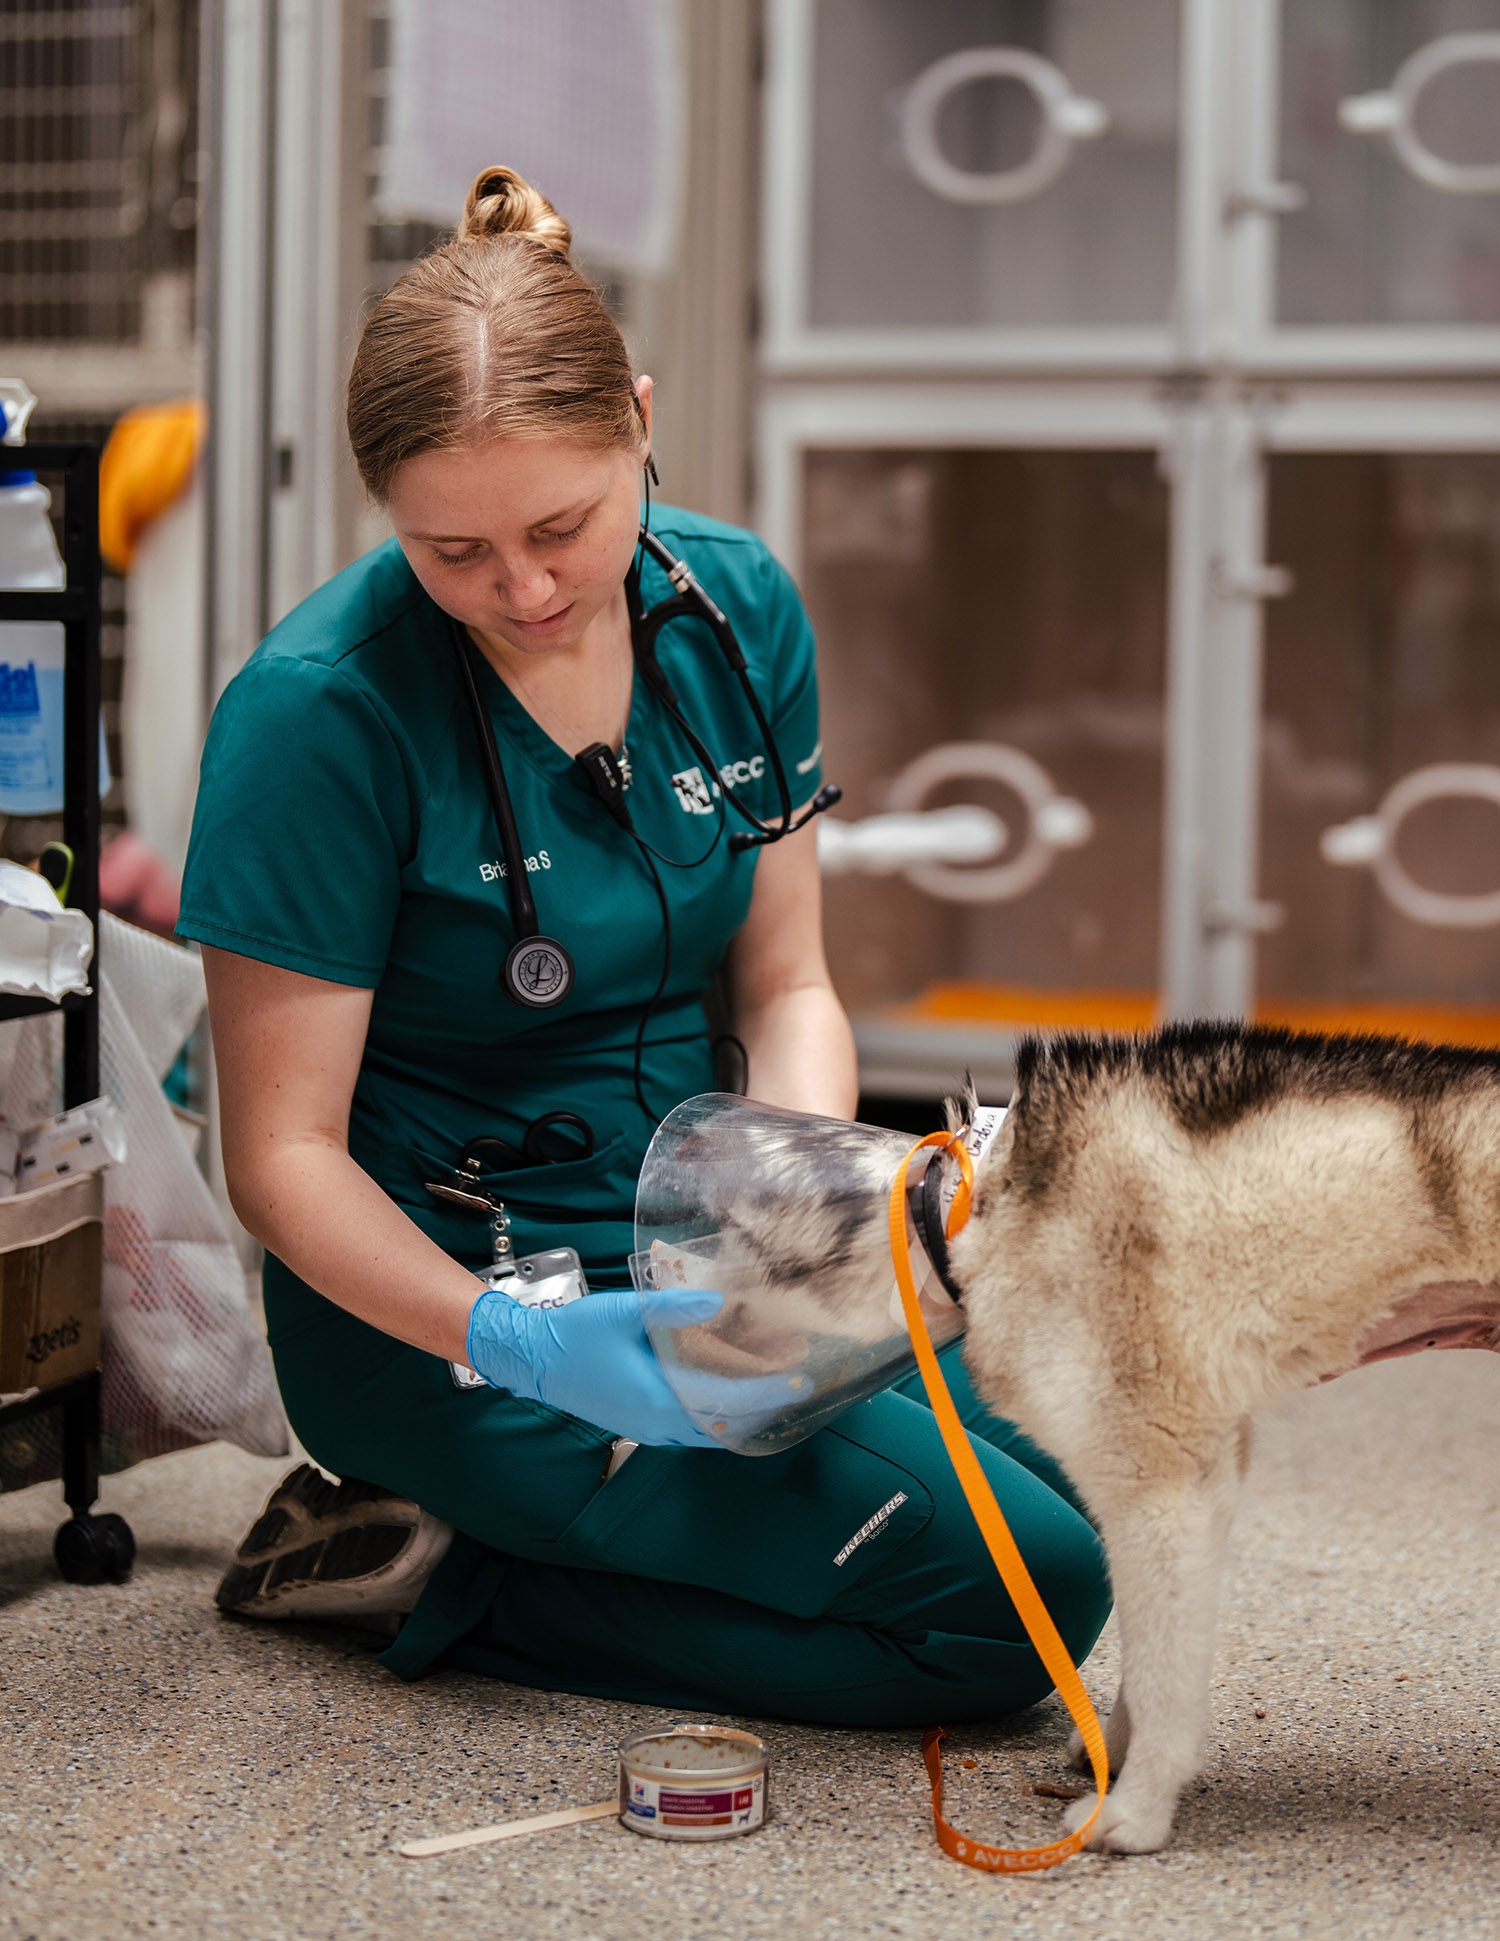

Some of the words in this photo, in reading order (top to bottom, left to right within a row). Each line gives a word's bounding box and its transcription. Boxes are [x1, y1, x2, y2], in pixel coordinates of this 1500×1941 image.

[539, 850, 551, 870] S
[967, 1113, 997, 1157] Cordova
[836, 1492, 905, 1564] SKECHERS
